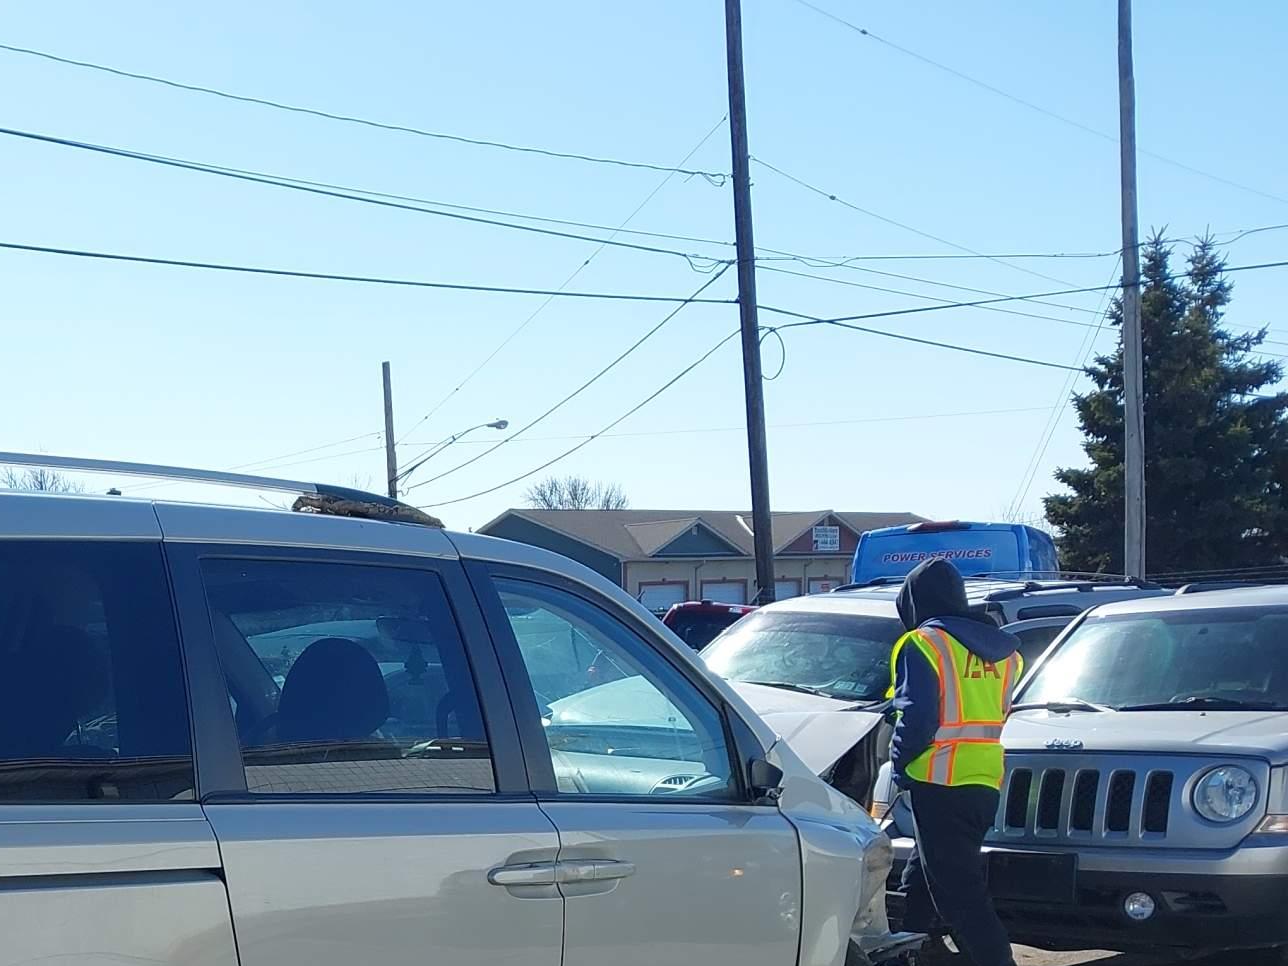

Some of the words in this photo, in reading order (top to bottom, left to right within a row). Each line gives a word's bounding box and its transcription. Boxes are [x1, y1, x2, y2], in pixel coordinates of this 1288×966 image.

[882, 552, 925, 563] POWER
[928, 549, 992, 560] SERVICES
[1043, 737, 1083, 749] Jeep
